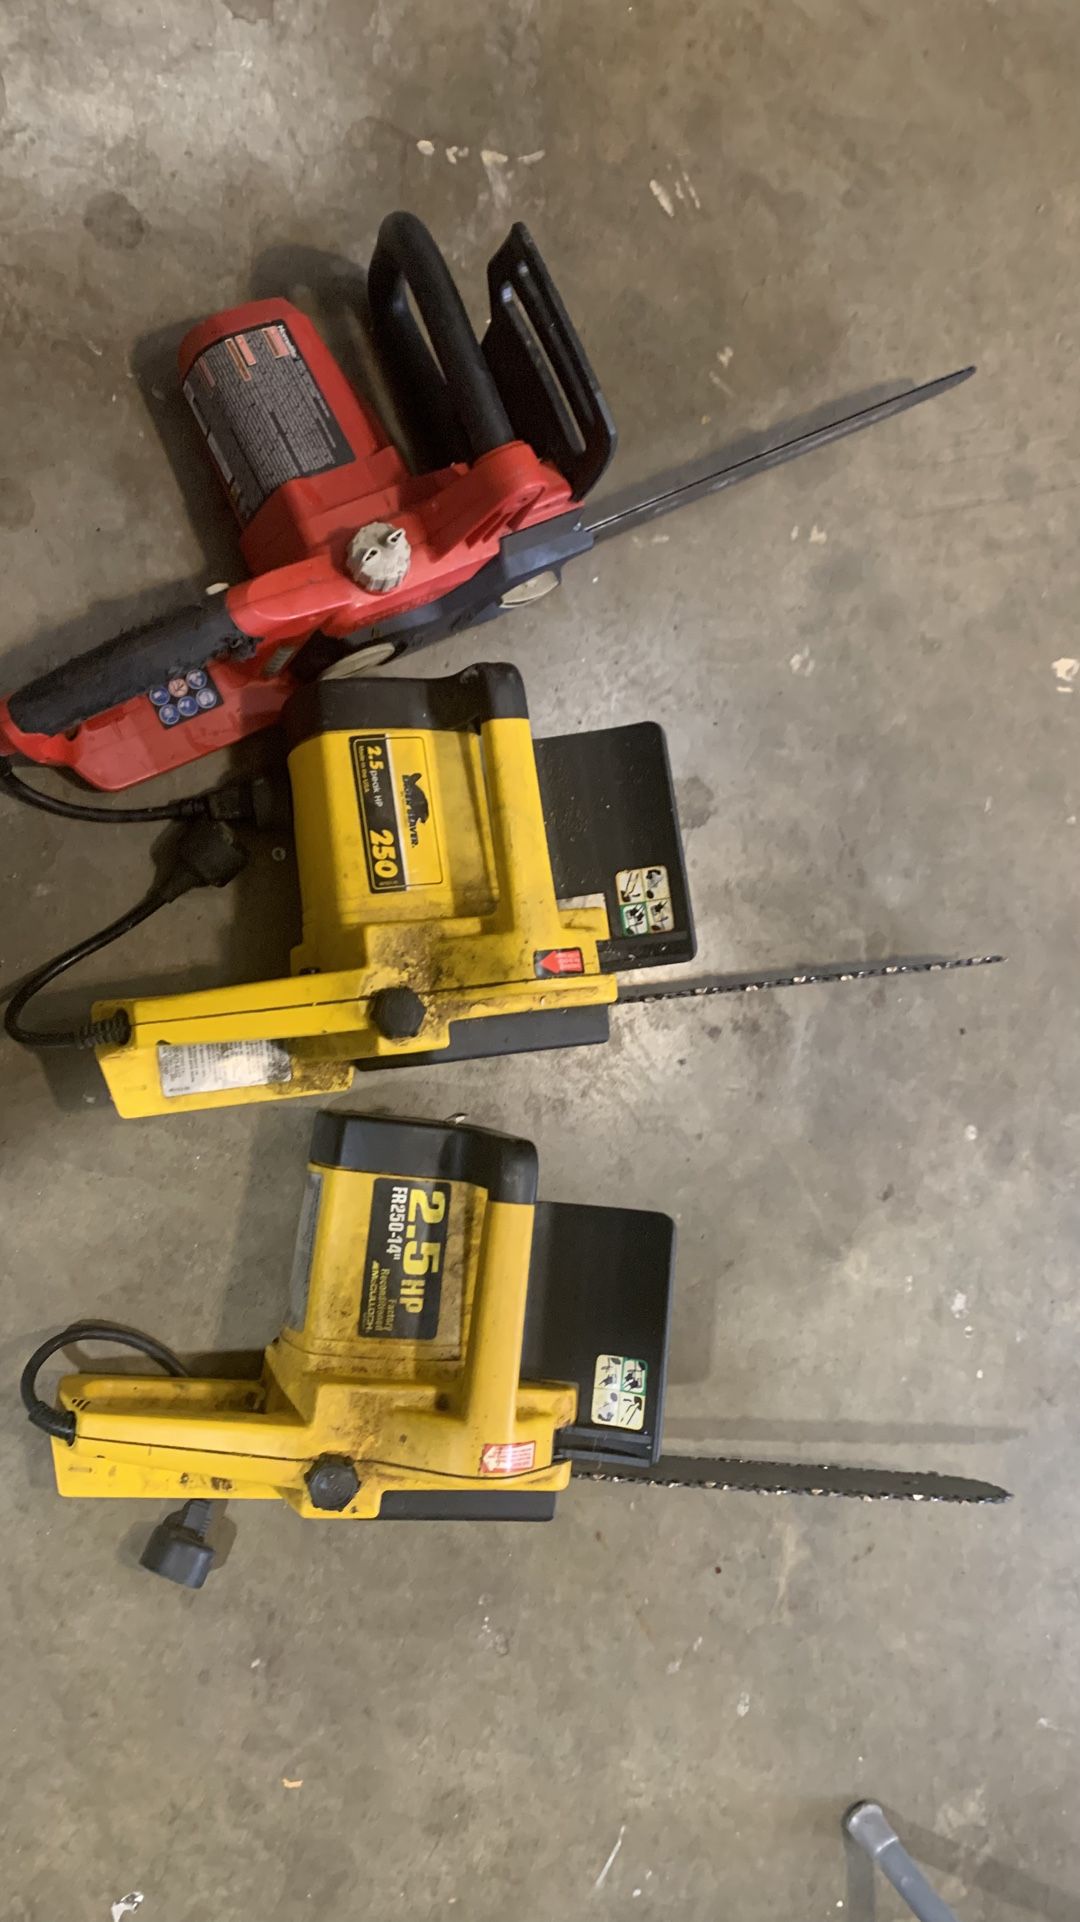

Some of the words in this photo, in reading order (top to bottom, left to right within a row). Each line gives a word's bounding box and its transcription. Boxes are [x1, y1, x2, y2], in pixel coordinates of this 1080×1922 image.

[367, 745, 384, 770] 2.5
[369, 770, 380, 793] peak
[374, 793, 383, 807] HP
[370, 829, 398, 878] 250
[386, 1186, 408, 1260] FR250-14"
[403, 1188, 446, 1276] 2.5
[399, 1279, 426, 1313] HP
[384, 1299, 397, 1331] Factory
